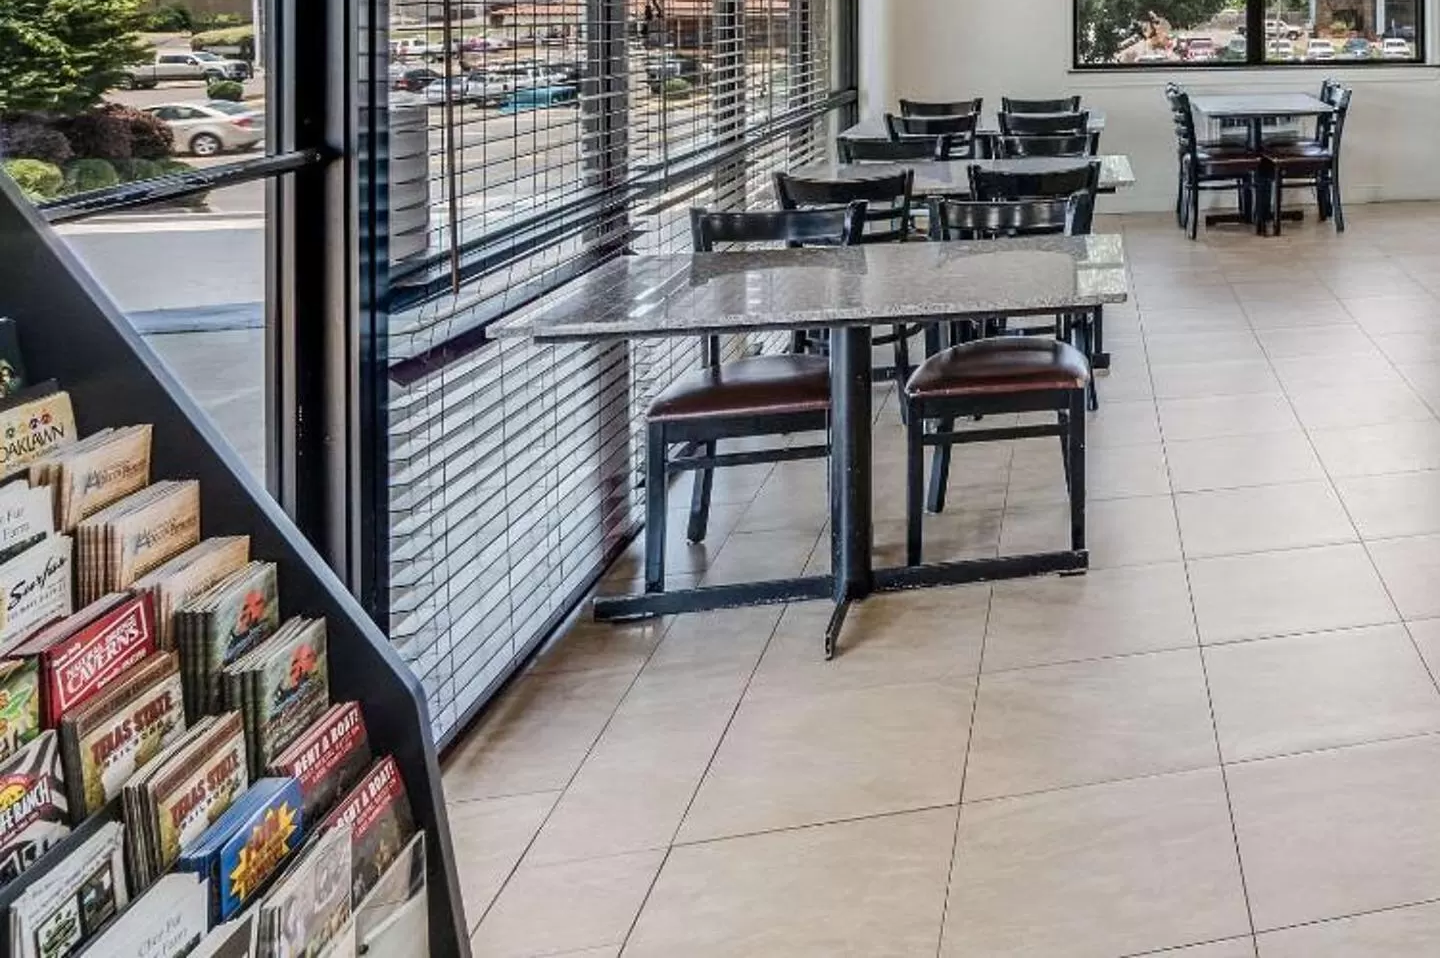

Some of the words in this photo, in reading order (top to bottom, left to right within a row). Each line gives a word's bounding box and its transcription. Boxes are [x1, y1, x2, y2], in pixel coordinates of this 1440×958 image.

[67, 628, 140, 694] CAVERNS
[293, 742, 321, 777] RENT
[322, 735, 330, 753] A
[361, 790, 369, 806] A
